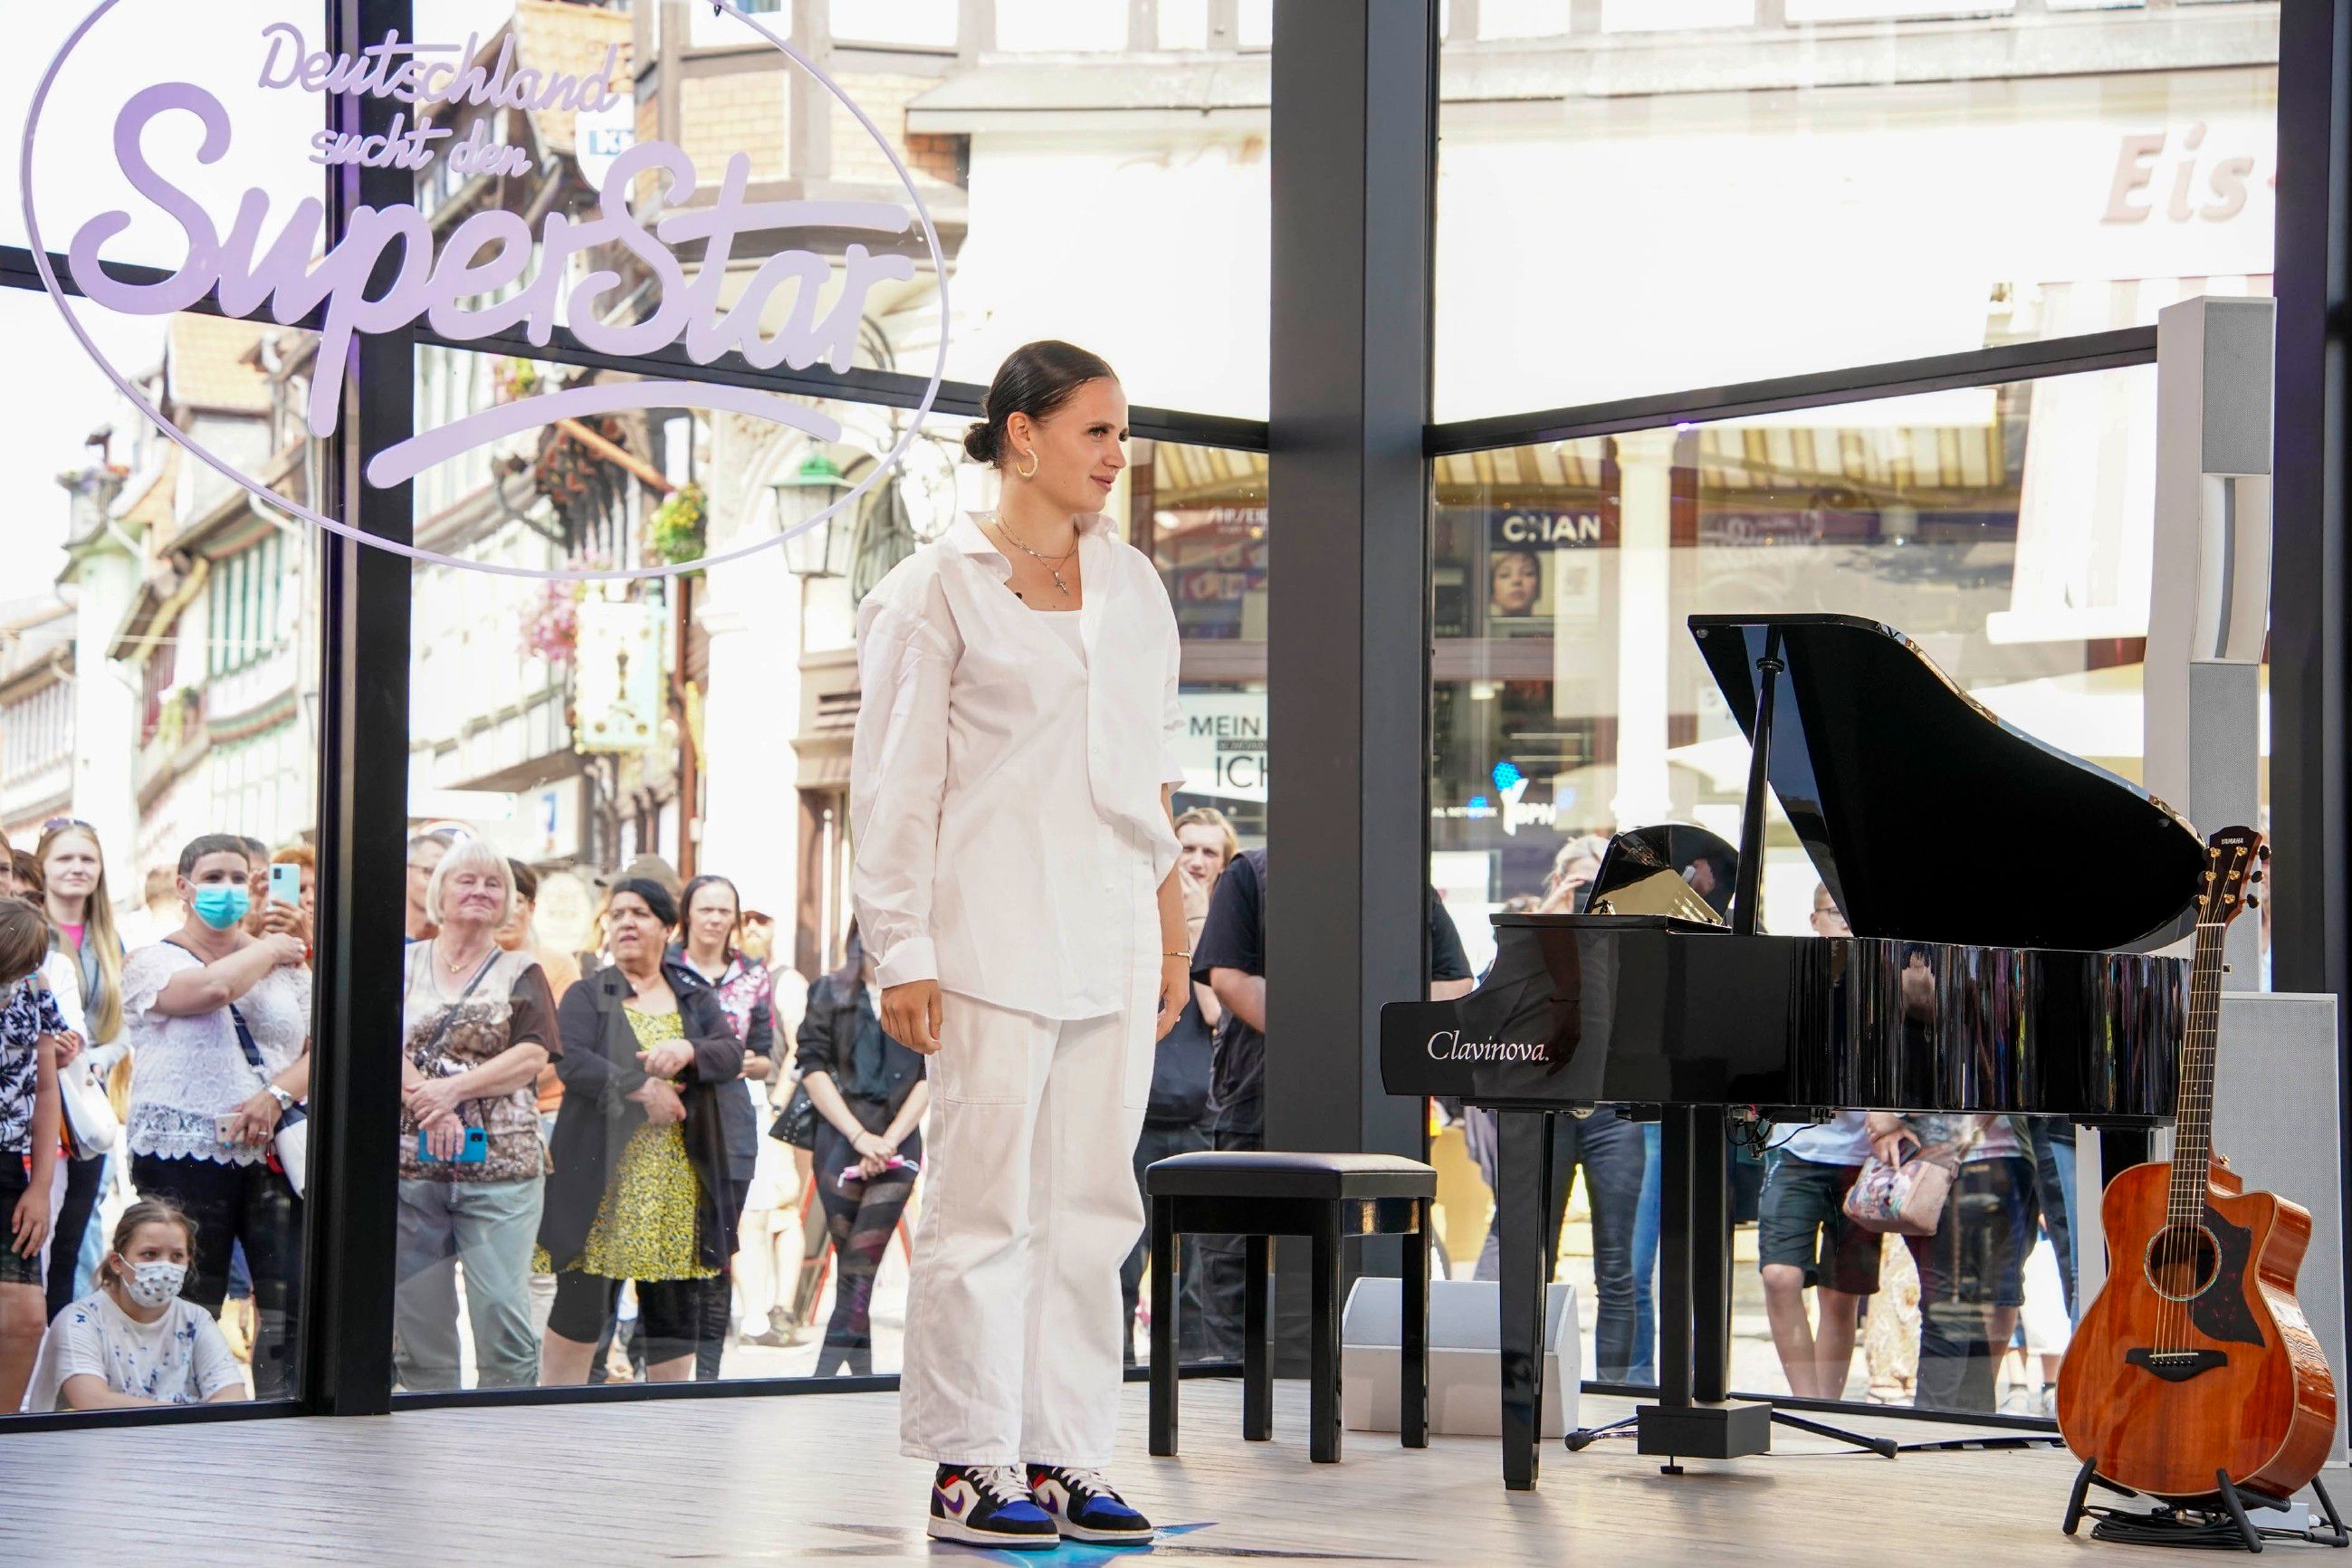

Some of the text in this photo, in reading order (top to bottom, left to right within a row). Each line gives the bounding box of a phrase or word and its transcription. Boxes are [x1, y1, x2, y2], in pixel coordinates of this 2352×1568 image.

[258, 22, 620, 113] Deutschland
[309, 112, 532, 177] sucht den
[2099, 120, 2255, 225] Eis
[1190, 715, 1260, 736] MEIN
[2221, 837, 2244, 846] YAMAHA
